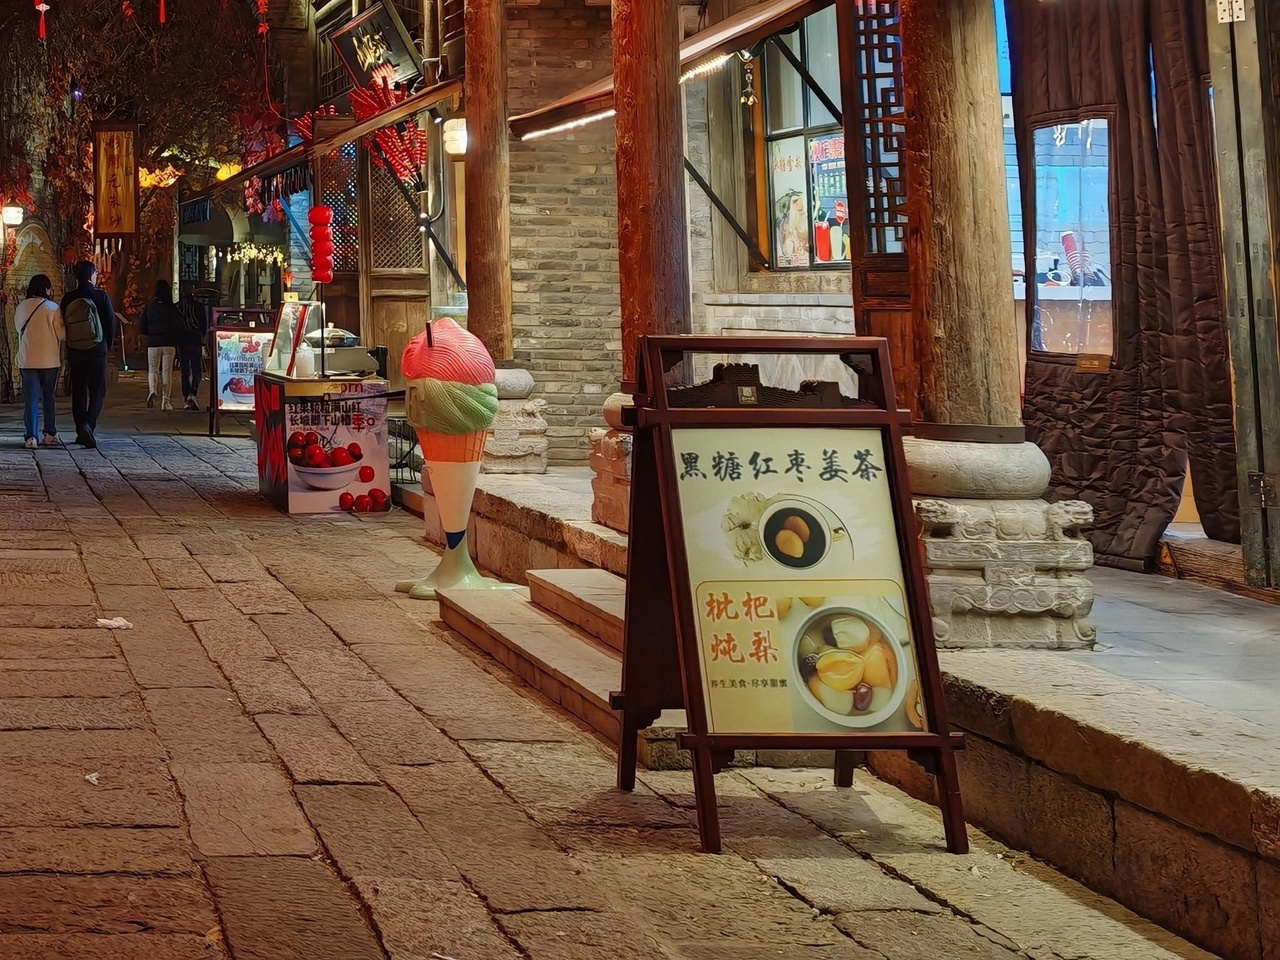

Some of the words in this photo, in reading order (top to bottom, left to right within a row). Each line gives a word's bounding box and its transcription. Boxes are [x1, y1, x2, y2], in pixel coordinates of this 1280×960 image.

[679, 448, 883, 483] 黑糖红枣姜茶
[705, 591, 775, 623] 枇杷
[710, 630, 779, 664] 炖梨
